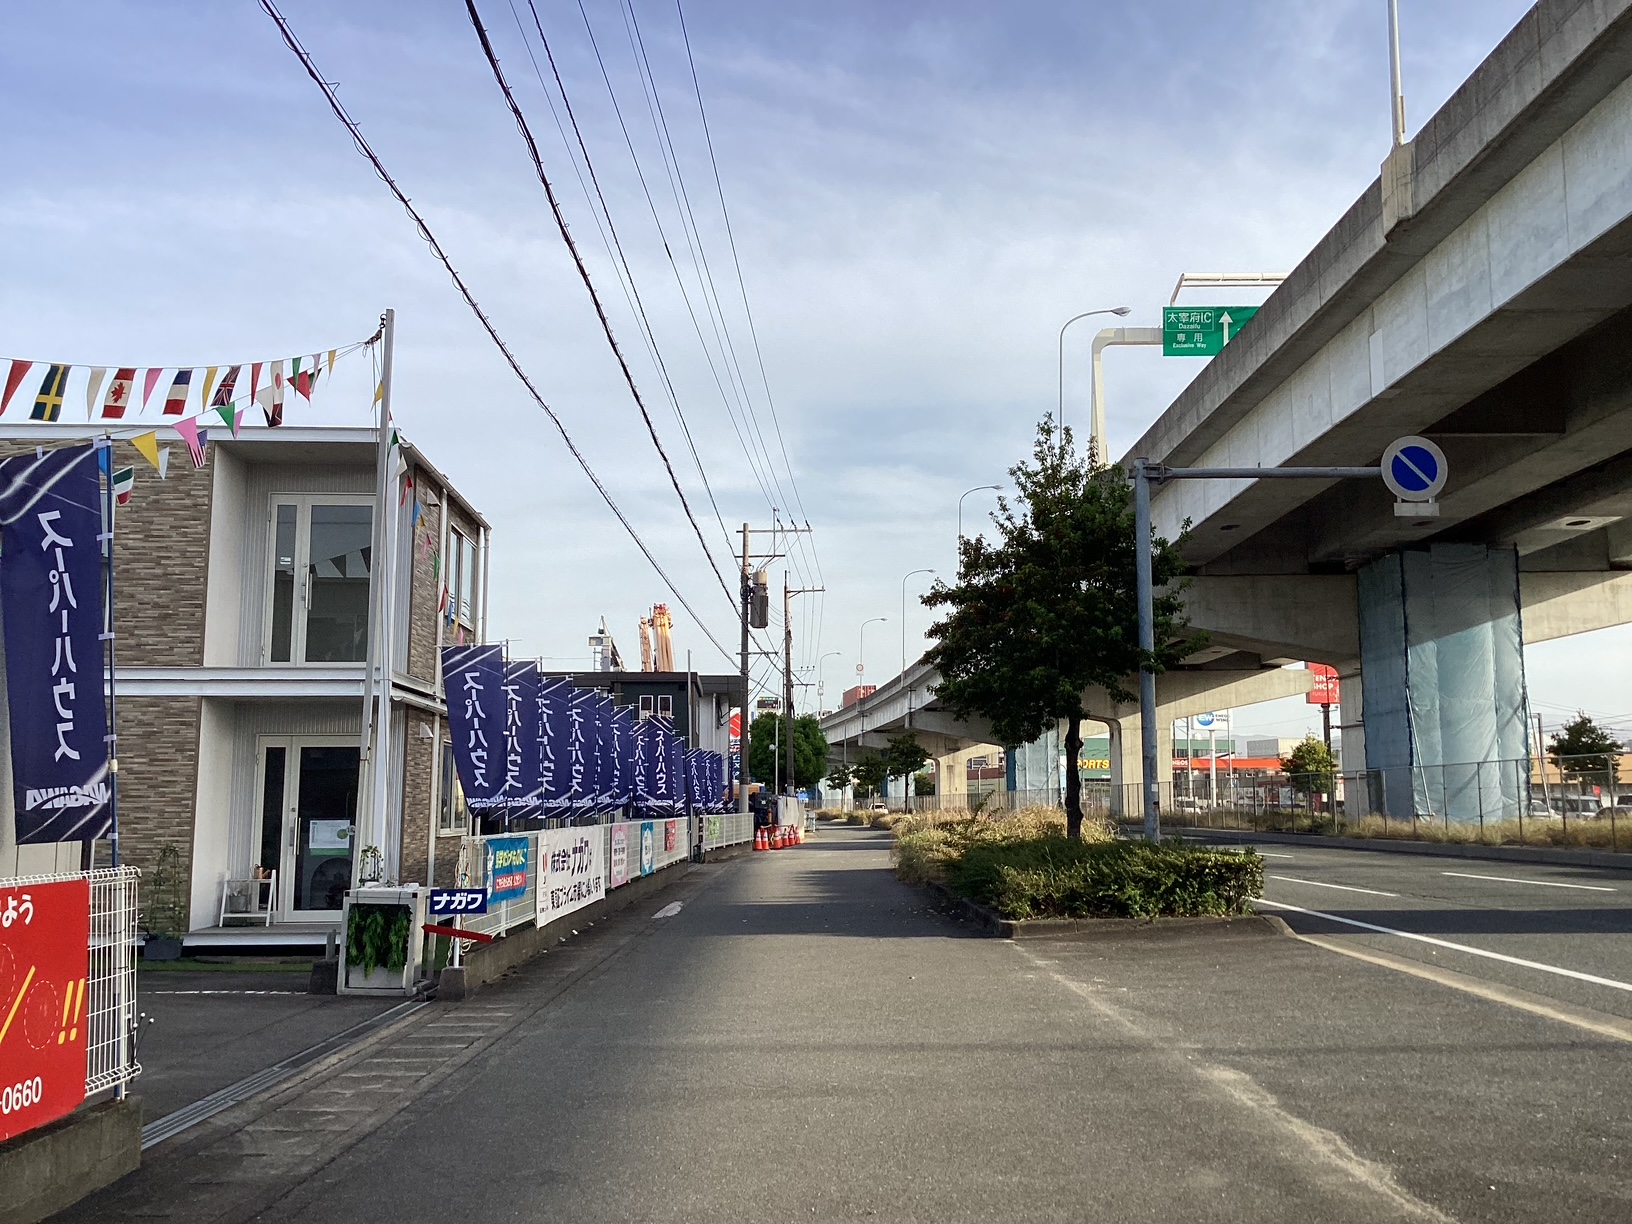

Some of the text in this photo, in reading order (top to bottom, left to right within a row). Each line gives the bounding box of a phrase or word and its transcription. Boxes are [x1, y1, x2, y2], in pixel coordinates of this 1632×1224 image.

[1167, 311, 1212, 323] 太宰府IC
[1076, 759, 1110, 769] PORTS
[433, 892, 483, 911] ナガワ
[0, 894, 34, 928] よう
